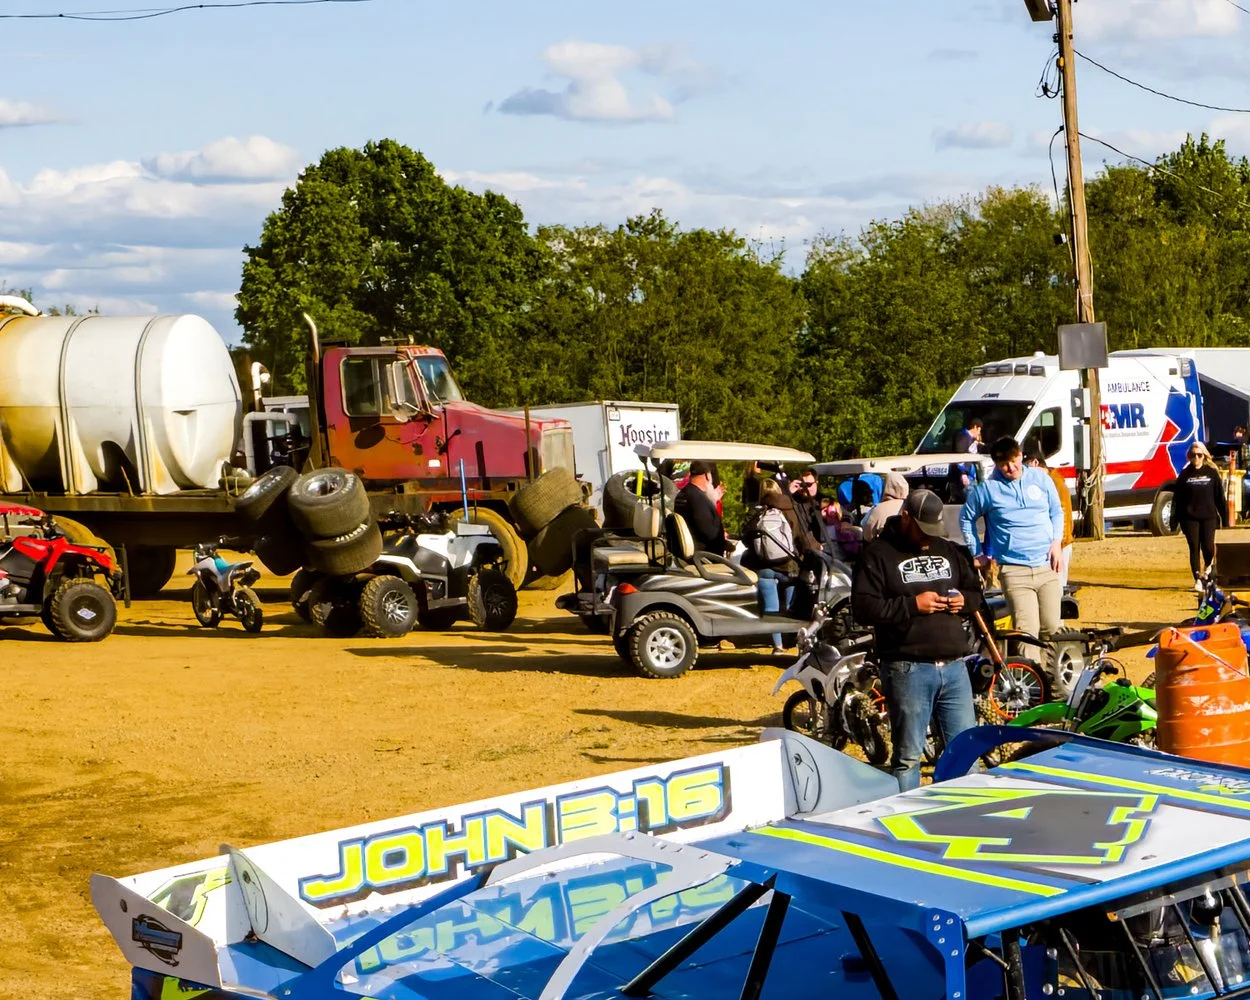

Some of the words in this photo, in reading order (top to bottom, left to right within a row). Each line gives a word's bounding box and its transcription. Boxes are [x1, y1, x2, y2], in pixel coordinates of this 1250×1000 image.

[1107, 381, 1150, 393] AMBULANCE
[1100, 403, 1146, 430] AMR
[618, 424, 669, 447] Hoosier
[299, 799, 547, 902] JOHN
[556, 762, 723, 844] 3:16
[908, 792, 1152, 860] 4
